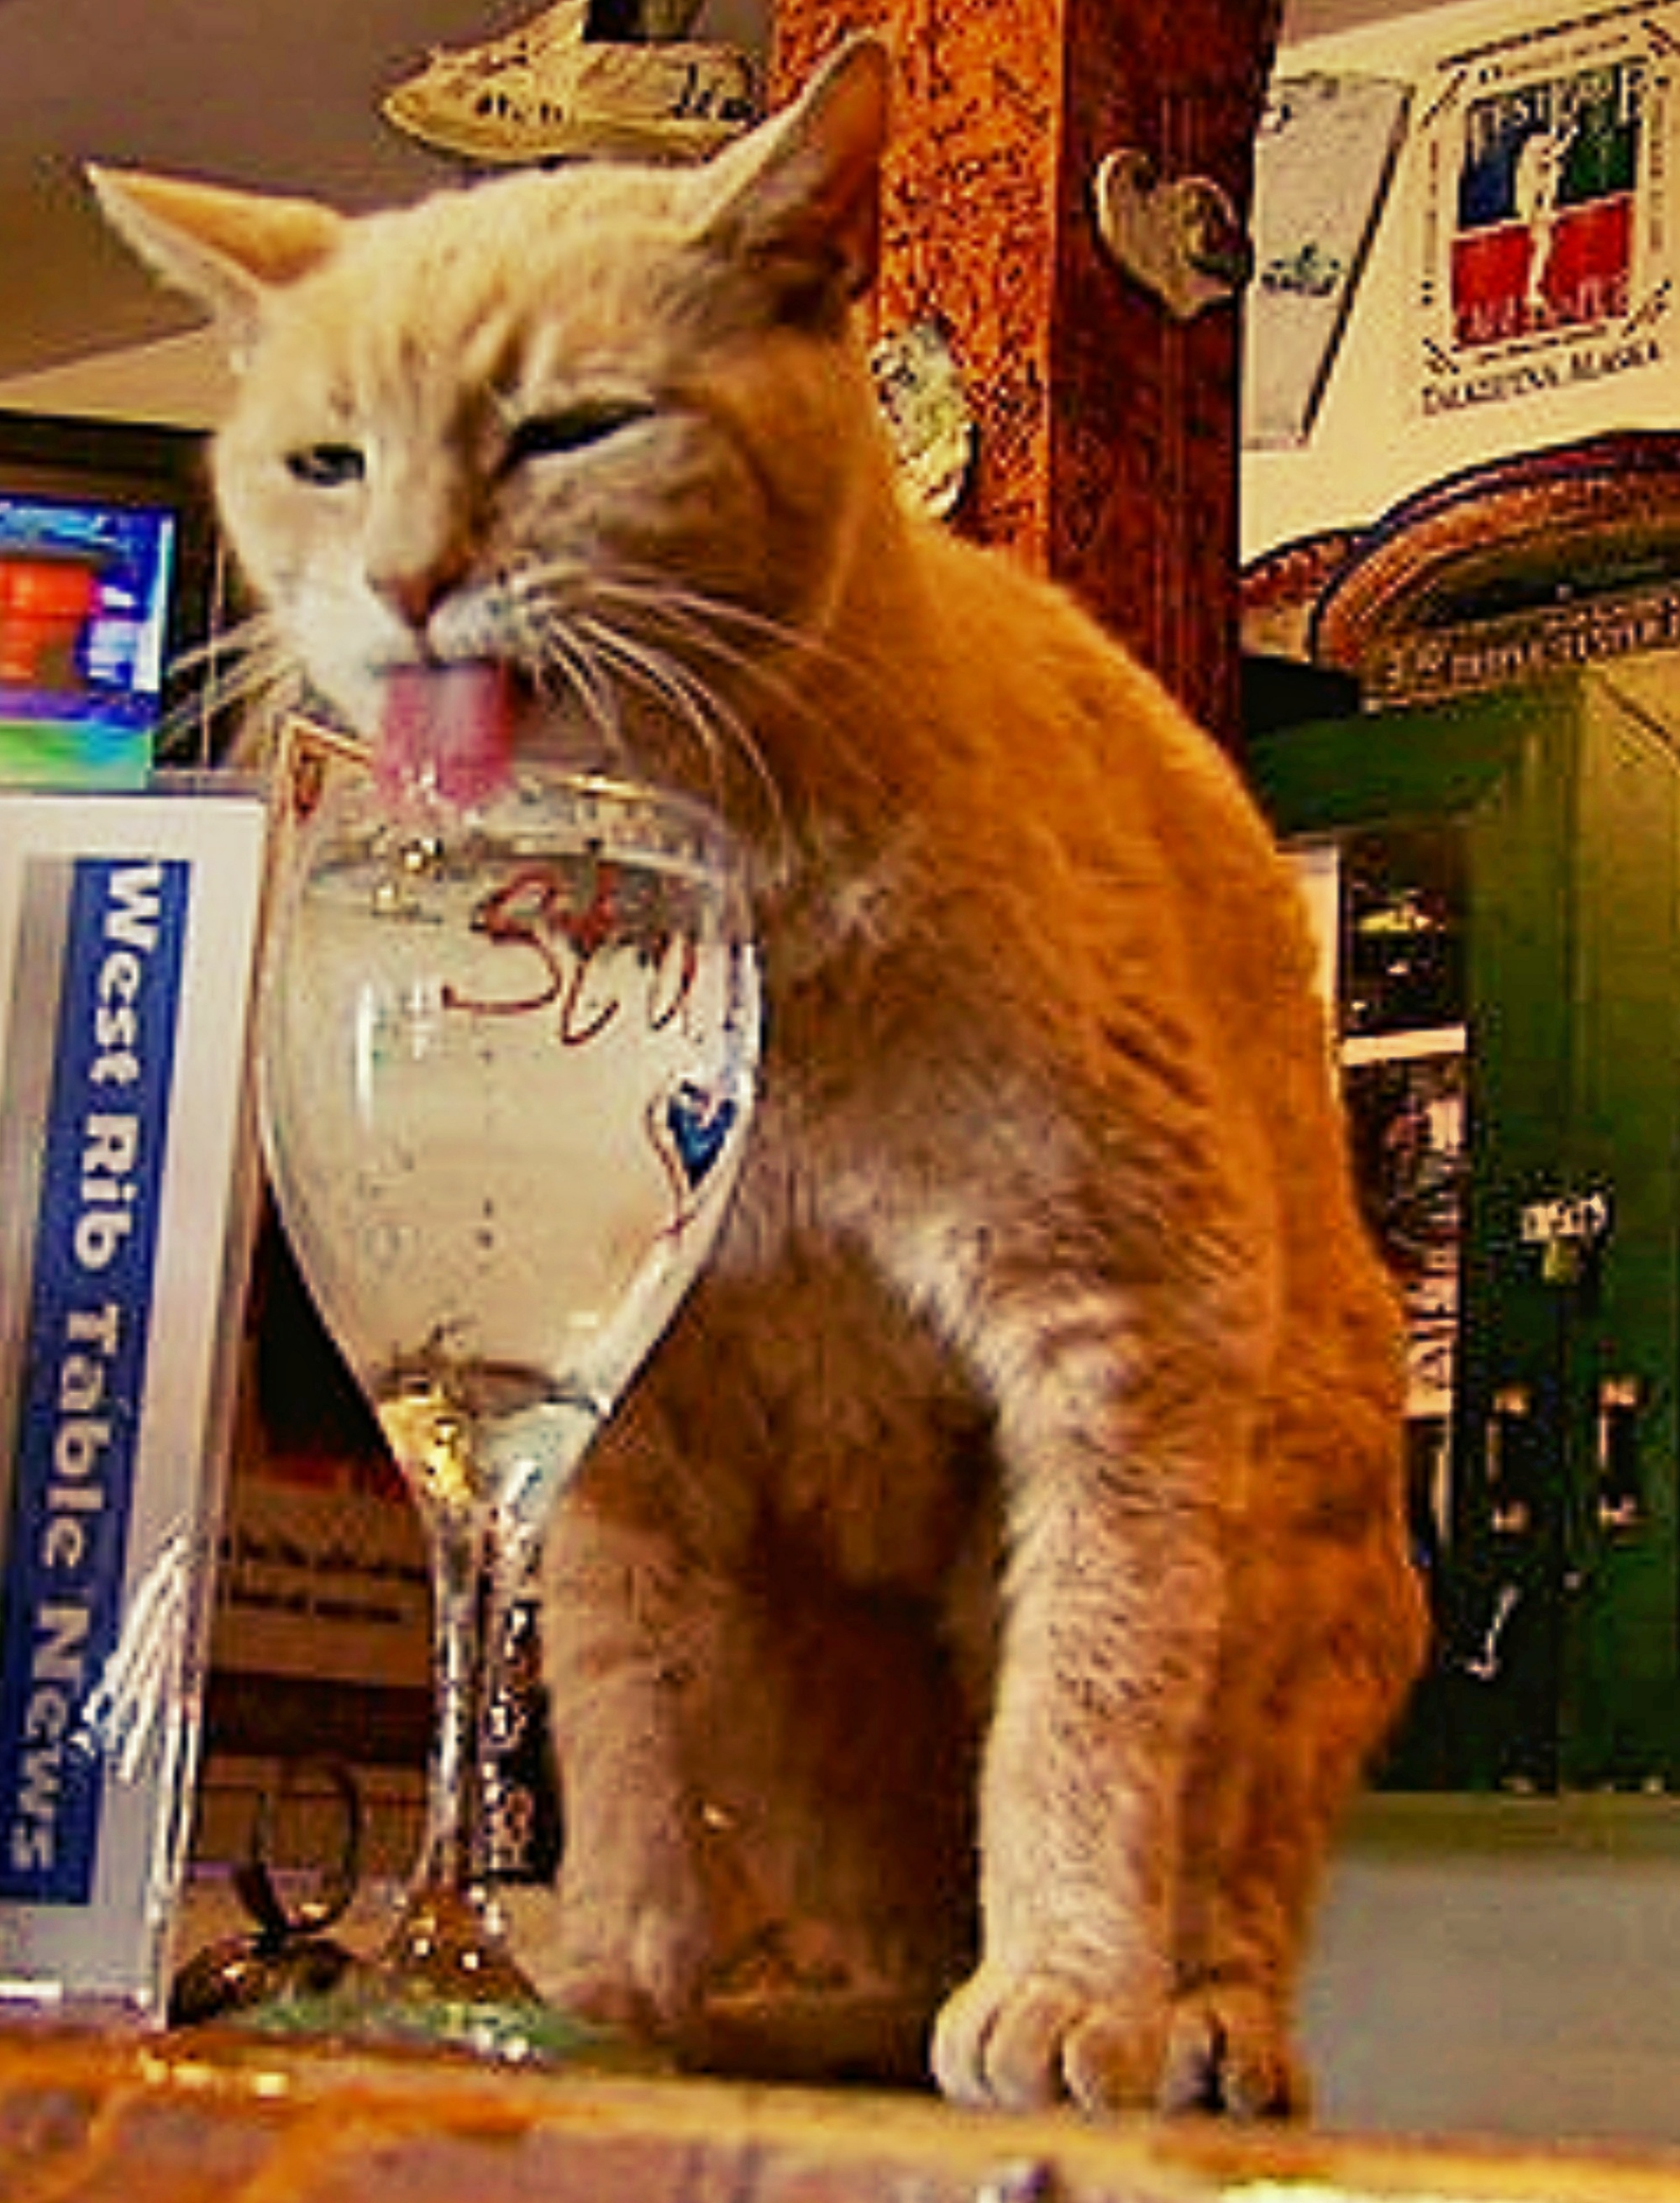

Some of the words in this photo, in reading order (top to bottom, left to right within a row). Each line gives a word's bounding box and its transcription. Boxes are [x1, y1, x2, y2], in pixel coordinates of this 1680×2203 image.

[90, 864, 163, 1086] West
[75, 1116, 139, 1268] Rib
[45, 1304, 119, 1566] Table
[17, 1606, 89, 1869] News
